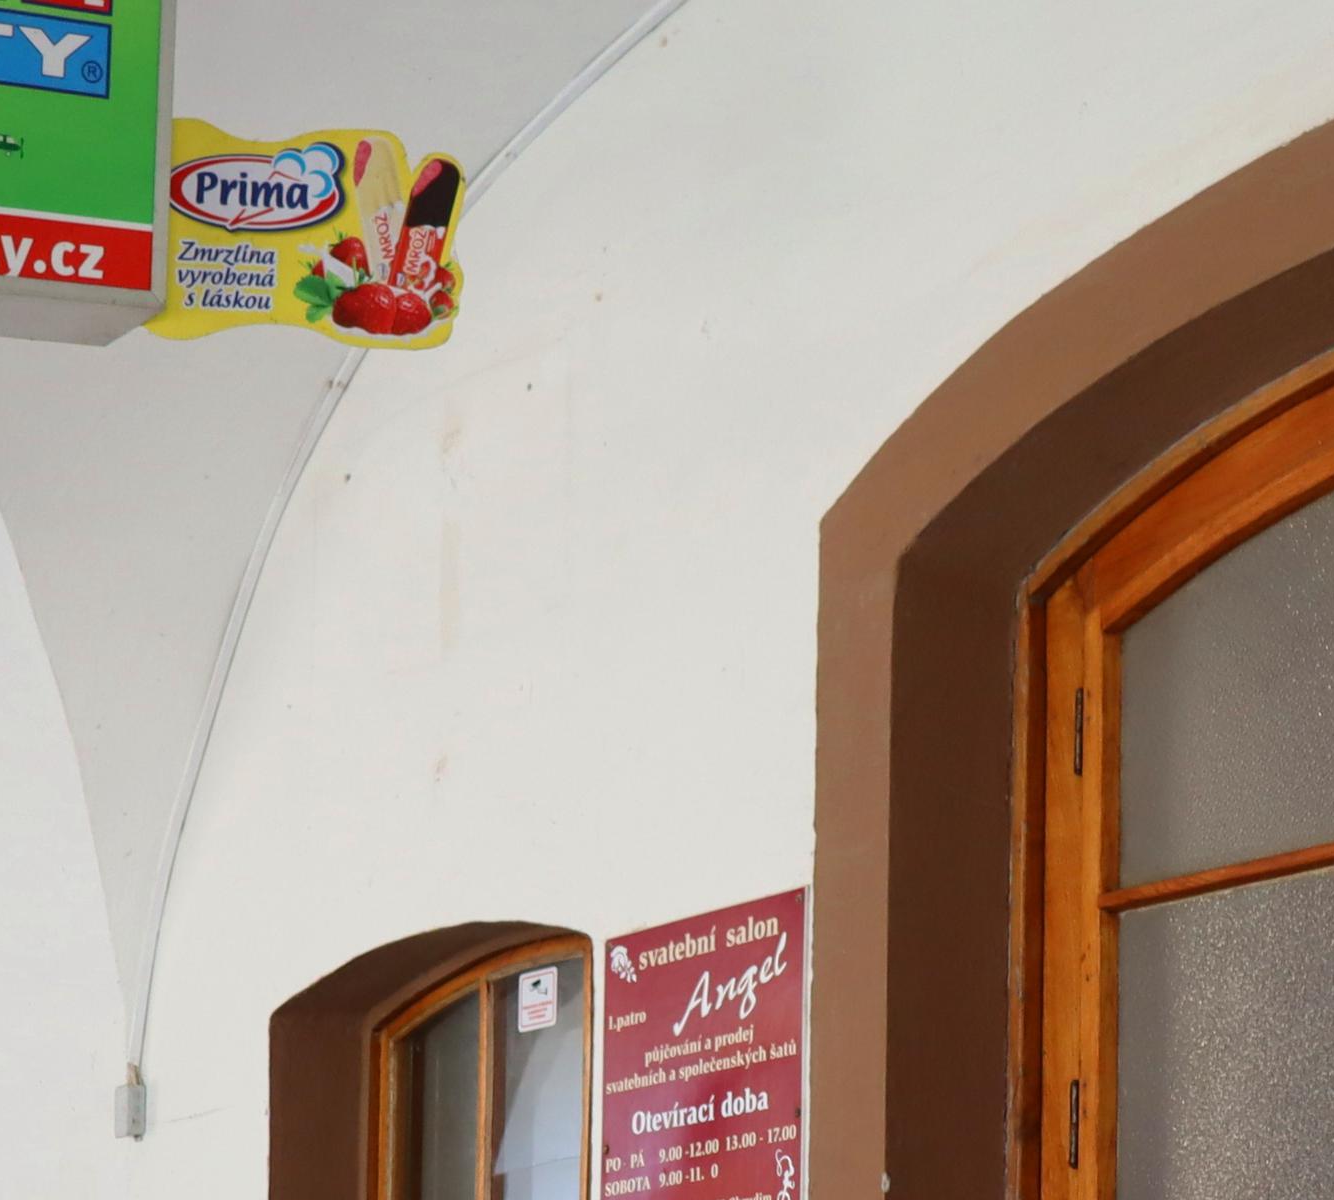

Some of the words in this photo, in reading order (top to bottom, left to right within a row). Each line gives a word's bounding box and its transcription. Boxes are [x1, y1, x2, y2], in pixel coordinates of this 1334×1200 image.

[195, 171, 310, 210] Prima
[177, 240, 276, 267] Zmrzlina
[177, 267, 276, 288] vyrobená
[184, 293, 195, 307] s
[201, 288, 272, 310] láskou
[638, 925, 716, 971] svatební
[726, 916, 779, 948] salon
[673, 931, 787, 1037] Angel
[605, 1066, 666, 1095] svatebních
[669, 1069, 676, 1081] a
[678, 1044, 767, 1082] společenských
[770, 1039, 797, 1060] šatů
[644, 1034, 702, 1067] půjčování
[704, 1038, 712, 1050] a
[714, 1024, 754, 1052] prodej
[631, 1094, 715, 1136] Otevírací
[720, 1087, 769, 1118] doba
[605, 1157, 621, 1174] PO
[630, 1149, 645, 1169] PÁ
[658, 1145, 683, 1164] 9.00
[725, 1131, 757, 1152] 13.00
[767, 1124, 797, 1144] 17.00
[604, 1176, 651, 1198] SOBOTA
[658, 1169, 683, 1188] 9.00
